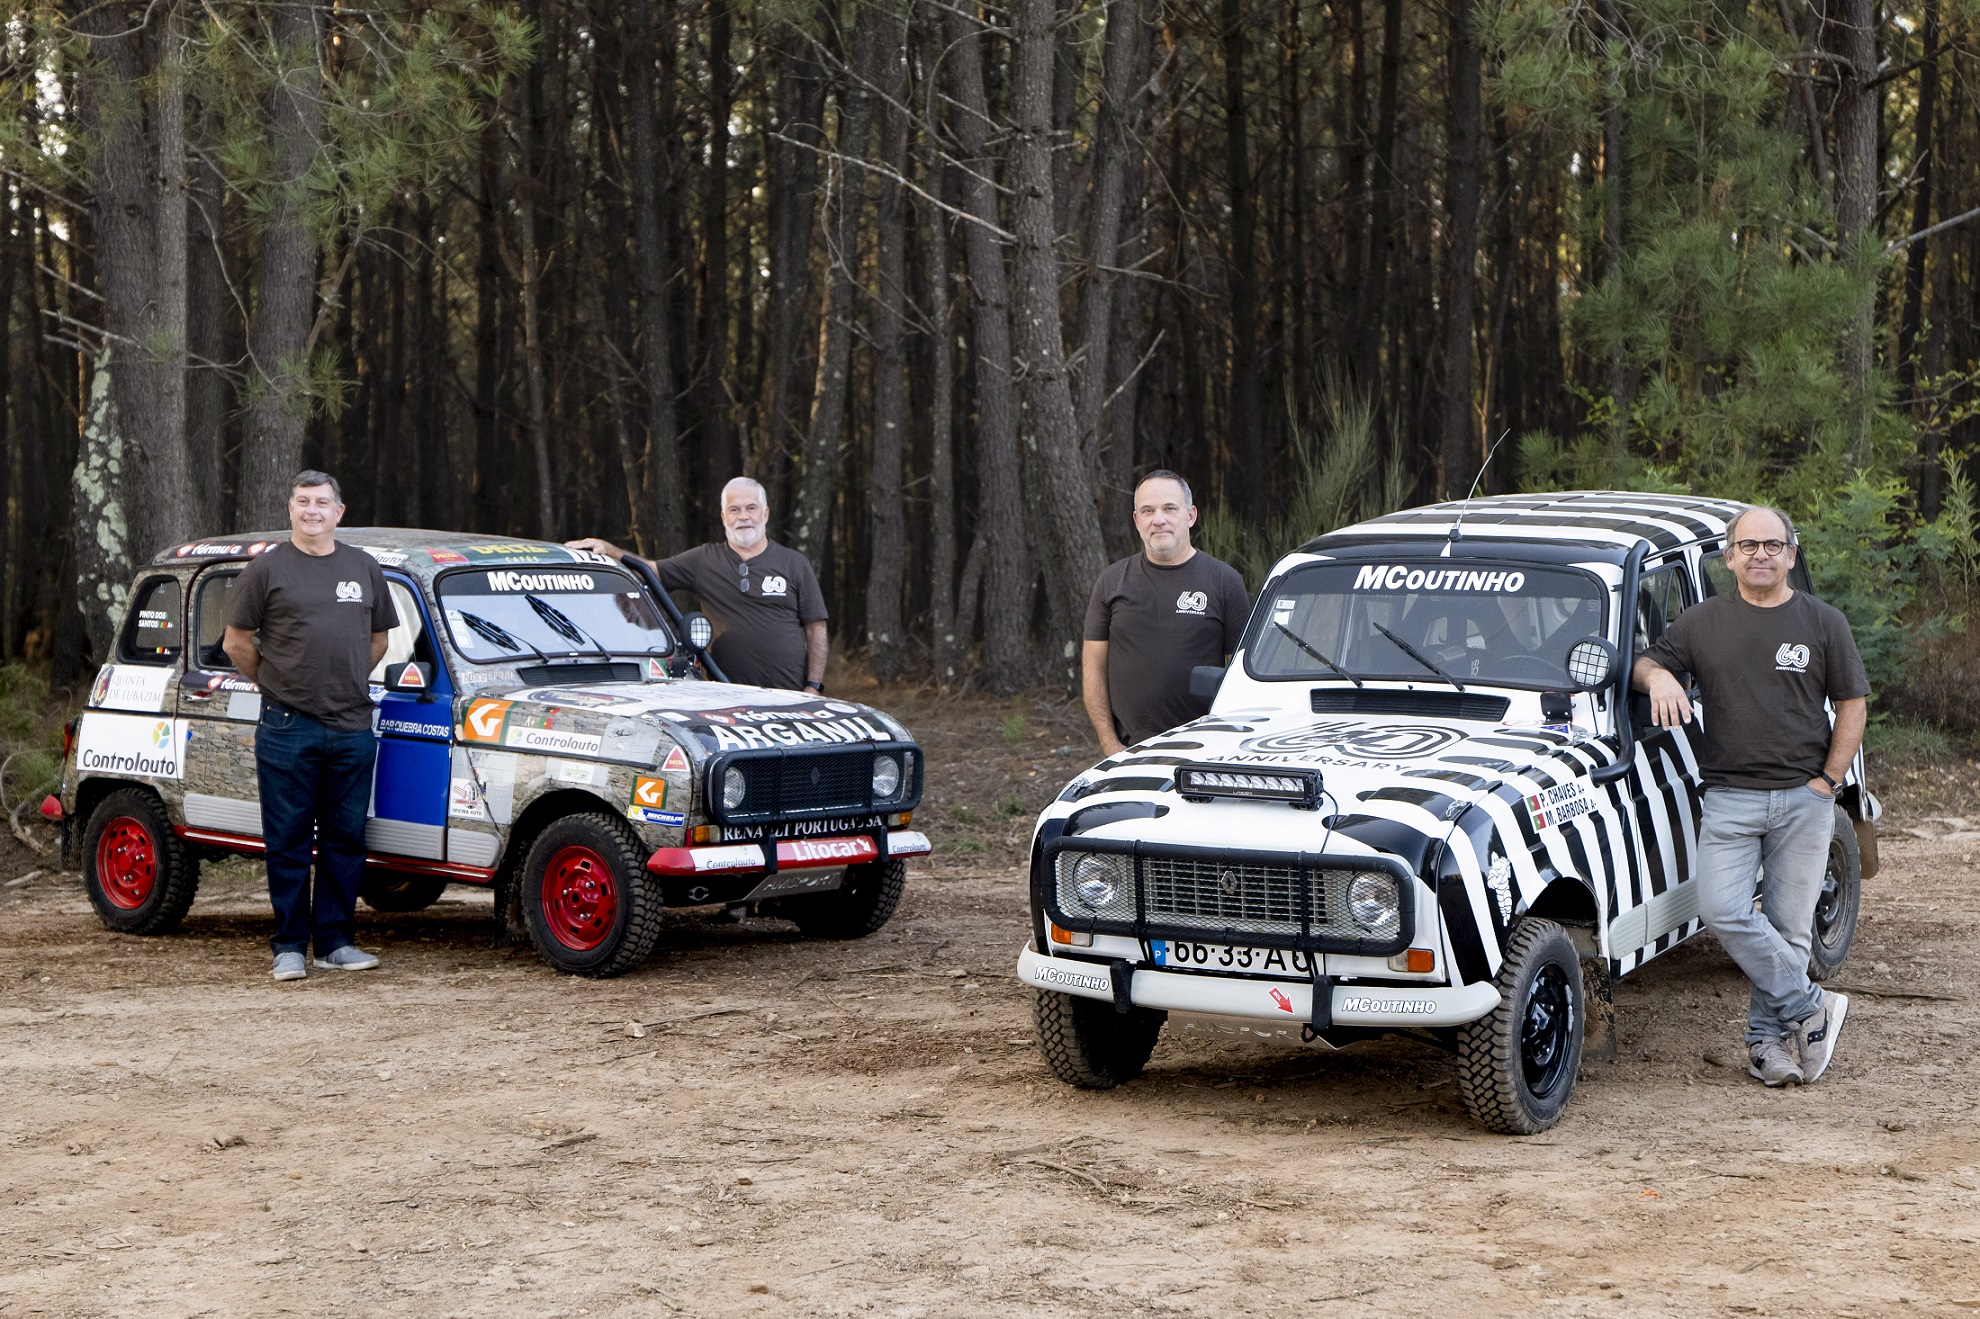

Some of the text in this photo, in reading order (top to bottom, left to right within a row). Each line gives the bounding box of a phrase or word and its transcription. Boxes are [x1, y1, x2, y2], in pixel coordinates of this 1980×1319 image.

[469, 544, 549, 554] DELTA
[487, 571, 595, 591] MCOUTINHO
[1353, 565, 1525, 593] MCOUTINHO
[1176, 590, 1208, 611] 60
[138, 620, 159, 628] SANTOS
[139, 610, 166, 620] PINTO DOS
[1775, 643, 1810, 668] 60
[112, 675, 145, 687] QUINTA
[108, 690, 121, 700] DE
[395, 721, 421, 734] QUEBRA
[423, 724, 449, 737] COSTAS
[709, 716, 891, 751] ARGANIL
[526, 732, 598, 752] Controlauto
[83, 749, 176, 775] Controlauto
[1206, 754, 1412, 772] ANNIVERSARY
[1539, 782, 1585, 808] P. CHAVES A+
[647, 812, 683, 822] MICHELIN
[1545, 811, 1557, 826] M.
[1556, 798, 1590, 822] BARBOSA
[791, 839, 857, 862] Litocar
[707, 857, 756, 870] Controlauto
[1155, 951, 1162, 959] P
[1035, 965, 1110, 991] MCOUTINHO
[1342, 997, 1437, 1014] MCOUTINHO
